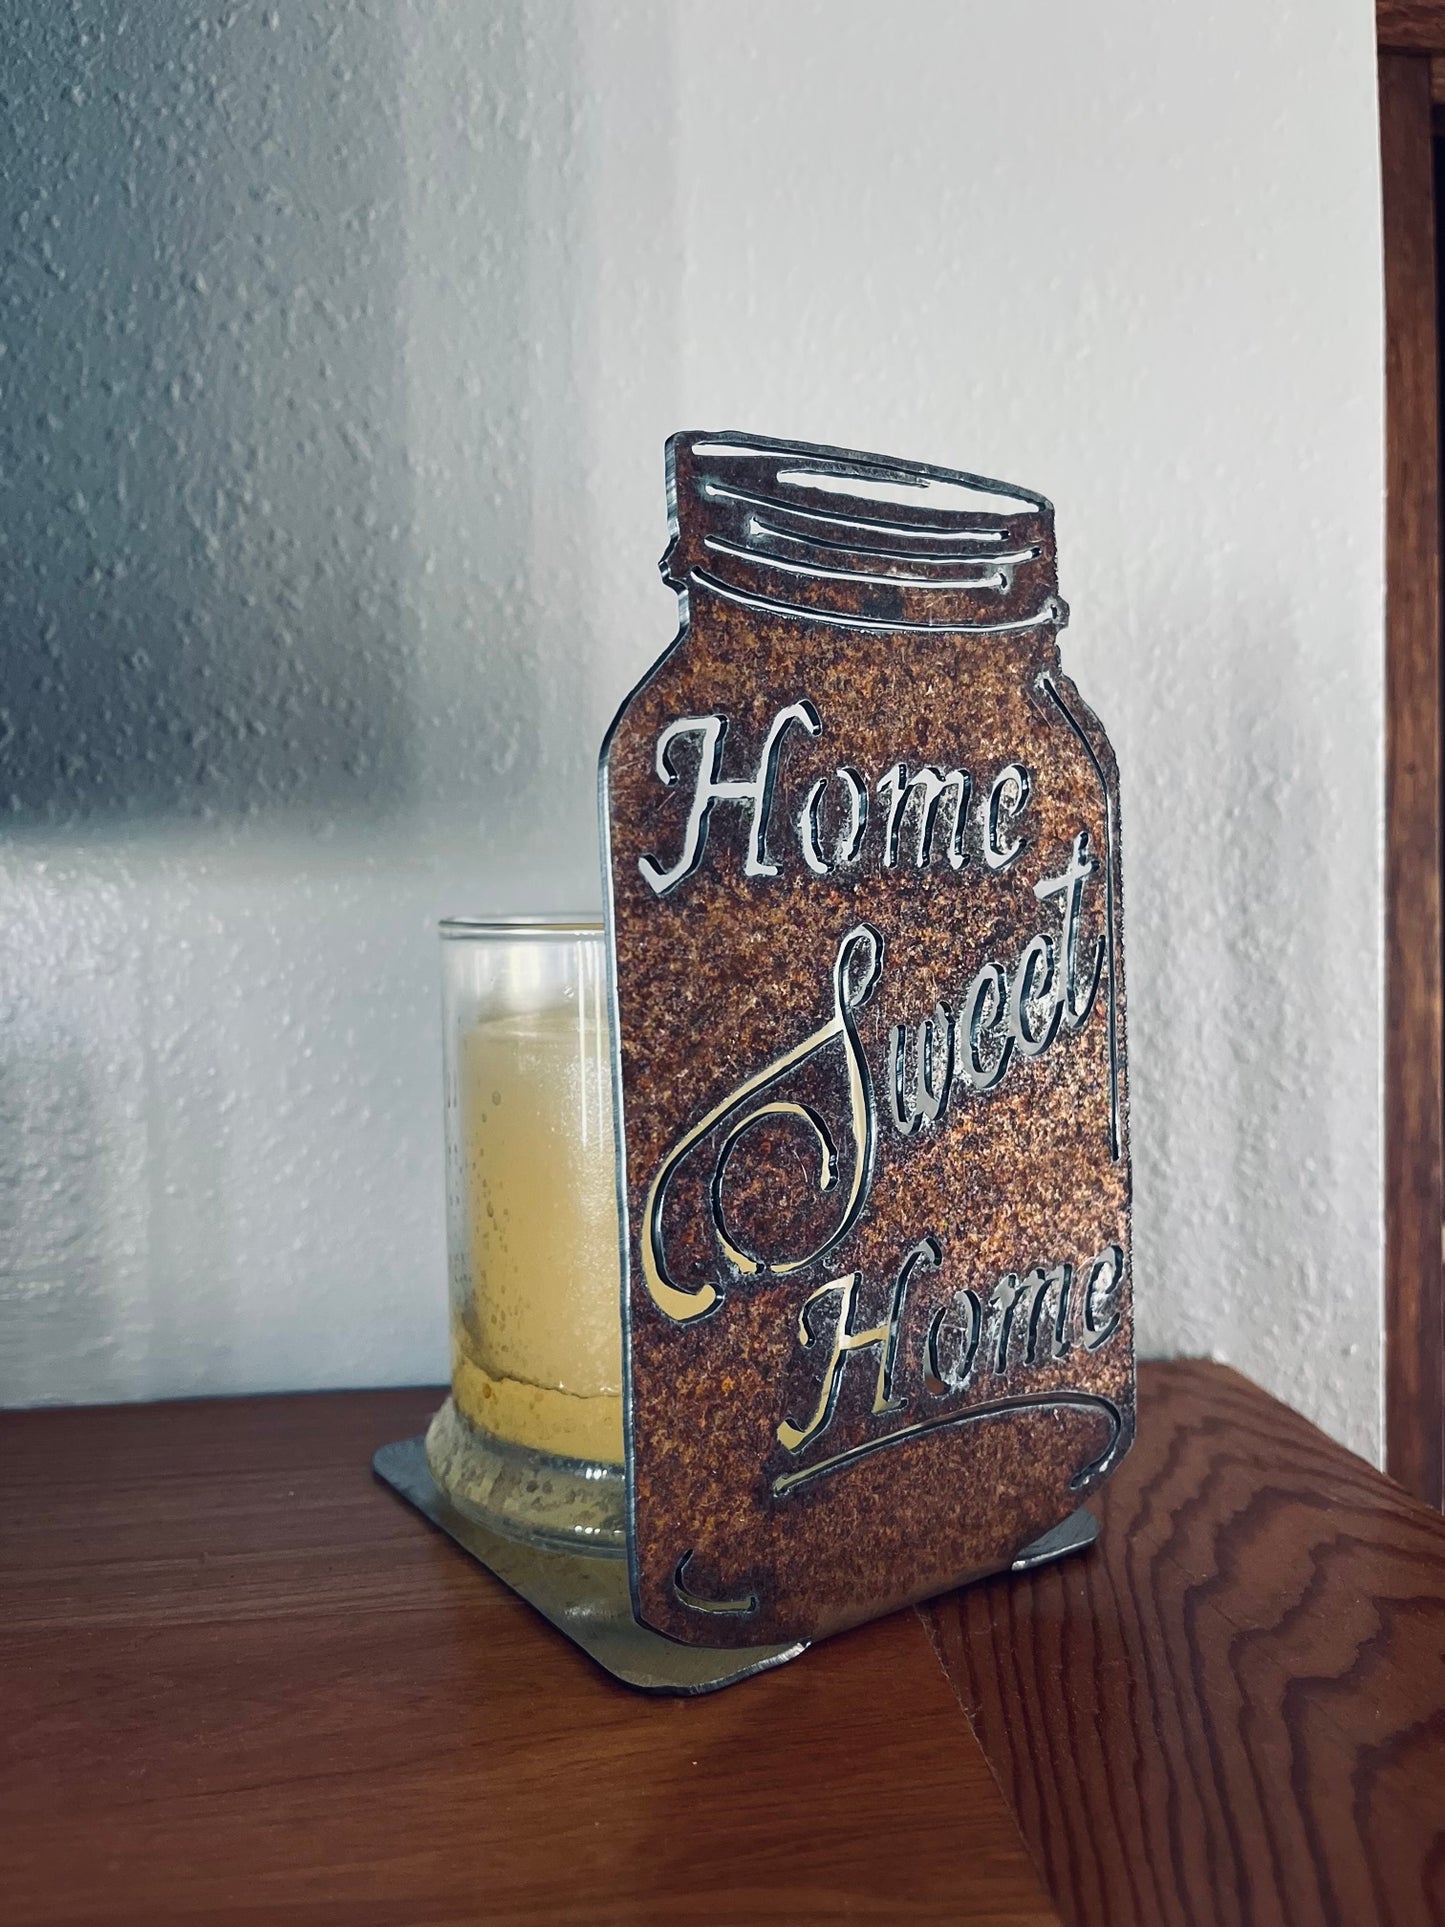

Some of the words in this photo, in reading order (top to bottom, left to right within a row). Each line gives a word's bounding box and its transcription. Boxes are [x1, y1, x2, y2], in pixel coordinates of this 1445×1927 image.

[638, 699, 1031, 894] Home
[642, 831, 1106, 1323] Sweet
[776, 1238, 1123, 1453] Home
